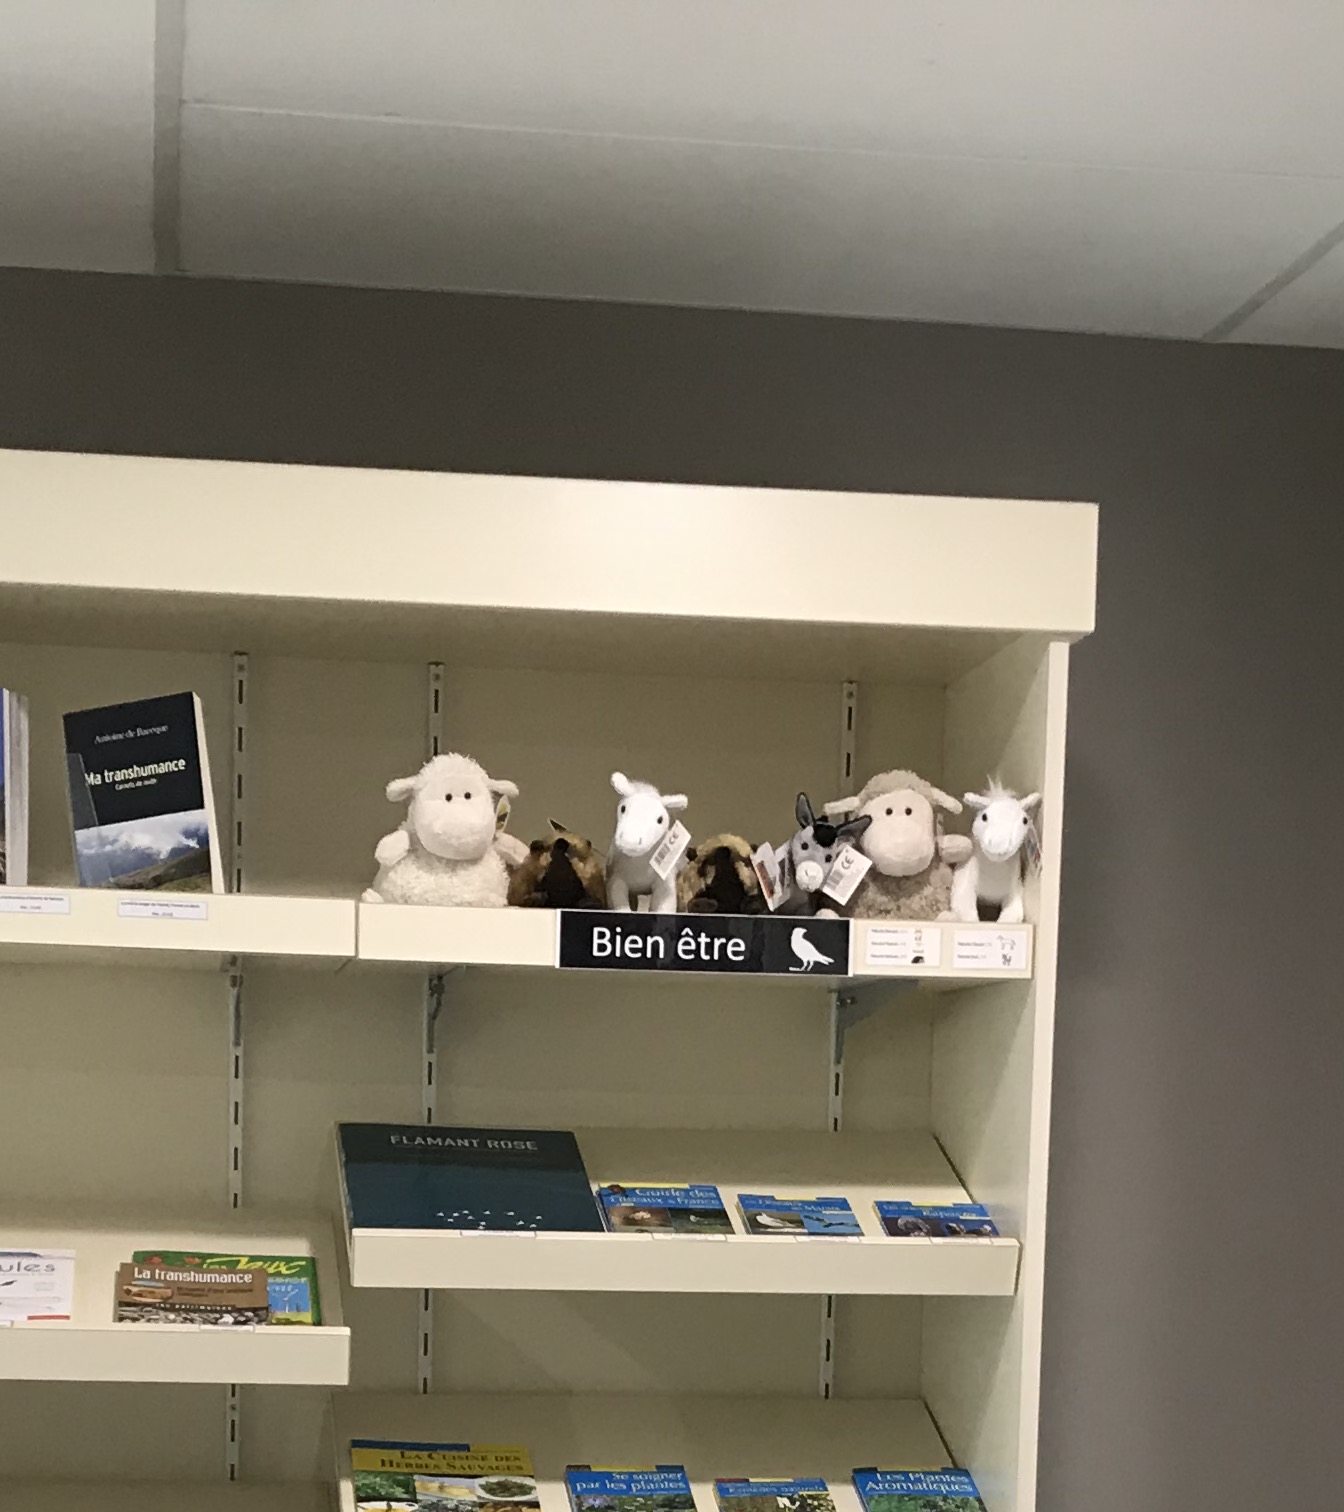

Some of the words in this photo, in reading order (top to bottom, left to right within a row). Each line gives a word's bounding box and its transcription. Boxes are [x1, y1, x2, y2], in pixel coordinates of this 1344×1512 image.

[105, 758, 186, 782] transhumance
[592, 926, 665, 959] Bien
[677, 928, 746, 961] être
[390, 1134, 480, 1148] FLAMANT
[487, 1138, 538, 1151] ROSE
[134, 1267, 150, 1279] La
[155, 1269, 252, 1284] transhumance
[632, 1472, 683, 1483] soigner
[875, 1472, 905, 1481] Les
[908, 1472, 969, 1483] Plantes
[576, 1481, 601, 1492] par
[606, 1480, 627, 1491] les
[631, 1480, 686, 1493] plantes
[865, 1481, 973, 1493] Aromatiques
